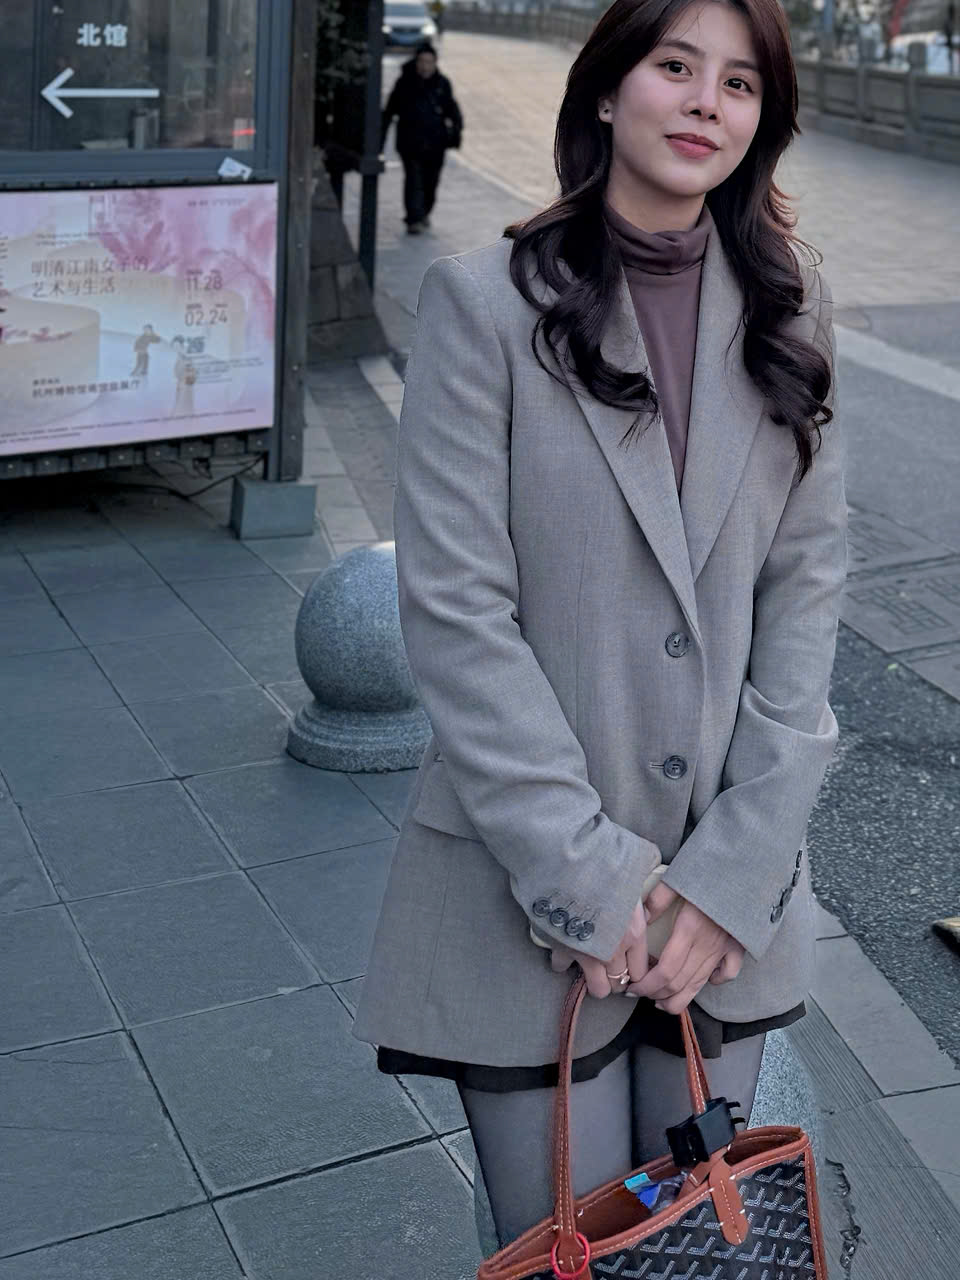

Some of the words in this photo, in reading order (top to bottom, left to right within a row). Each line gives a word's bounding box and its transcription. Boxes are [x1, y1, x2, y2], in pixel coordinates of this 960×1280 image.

[77, 23, 128, 47] 北馆
[31, 274, 116, 298] 艺术与生活
